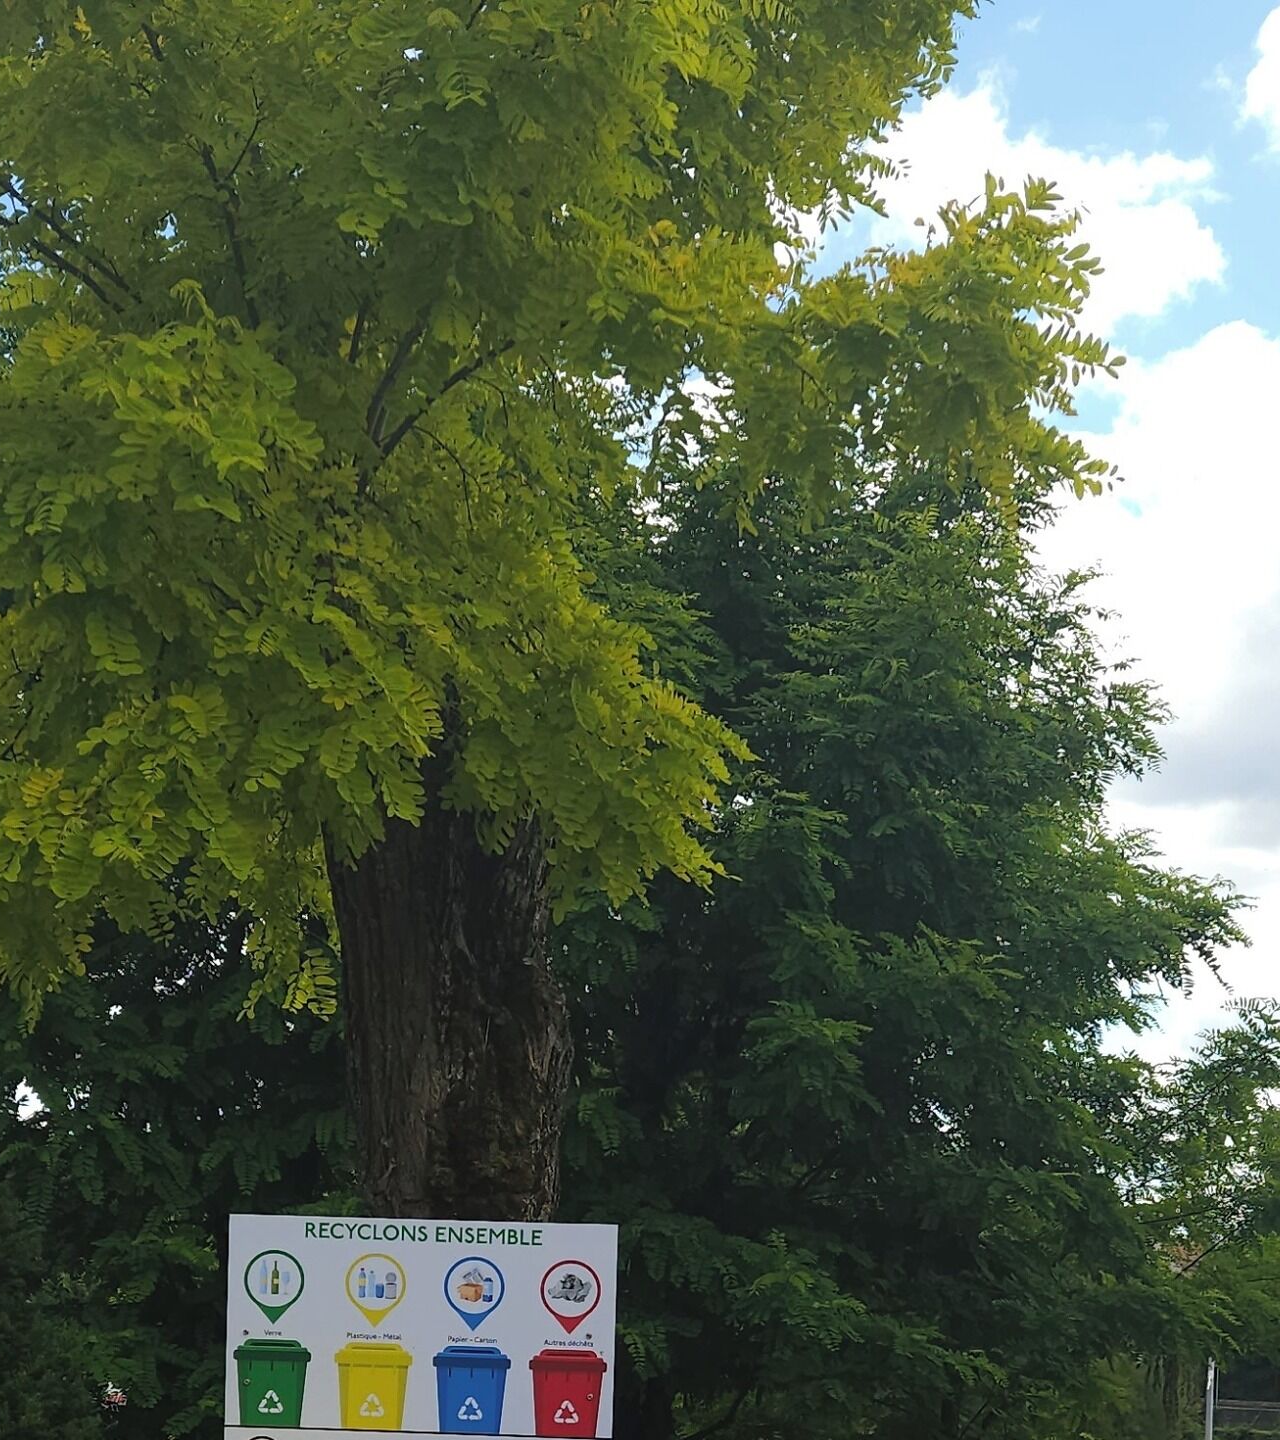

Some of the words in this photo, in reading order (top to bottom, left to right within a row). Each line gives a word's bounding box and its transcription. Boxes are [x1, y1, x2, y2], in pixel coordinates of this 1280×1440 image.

[305, 1222, 428, 1242] RECYCLONS
[435, 1226, 543, 1246] ENSEMBLE
[346, 1332, 377, 1340] Plastique
[382, 1333, 402, 1341] Métal
[474, 1336, 498, 1344] Carton
[543, 1339, 567, 1347] Autres
